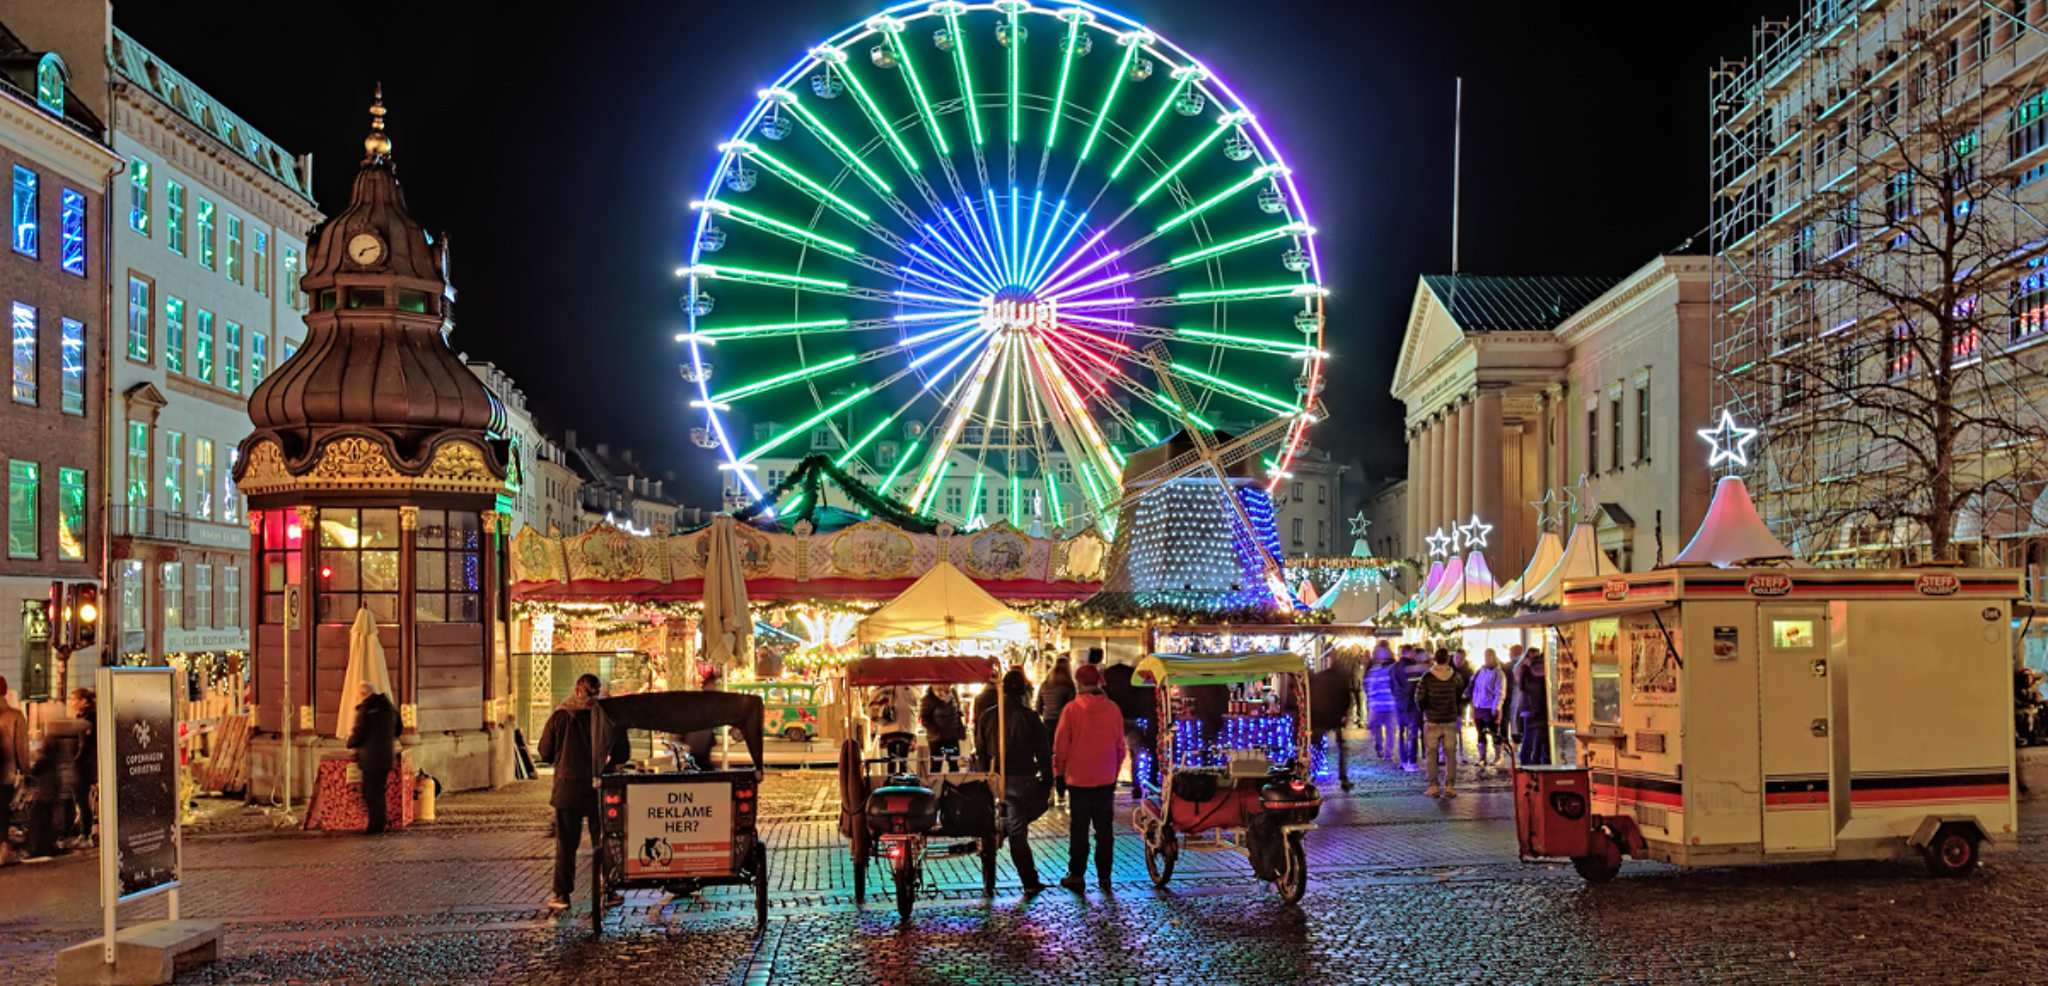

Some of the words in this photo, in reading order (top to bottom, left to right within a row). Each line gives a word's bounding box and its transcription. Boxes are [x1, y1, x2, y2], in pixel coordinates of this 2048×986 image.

[1754, 576, 1785, 587] STEFF
[1923, 576, 1954, 587] STEFF
[126, 752, 163, 765] COPENHAGEN
[130, 763, 161, 775] CHRISTMAS
[668, 792, 694, 804] DIN
[648, 806, 713, 818] REKLAME
[665, 821, 699, 833] HER?
